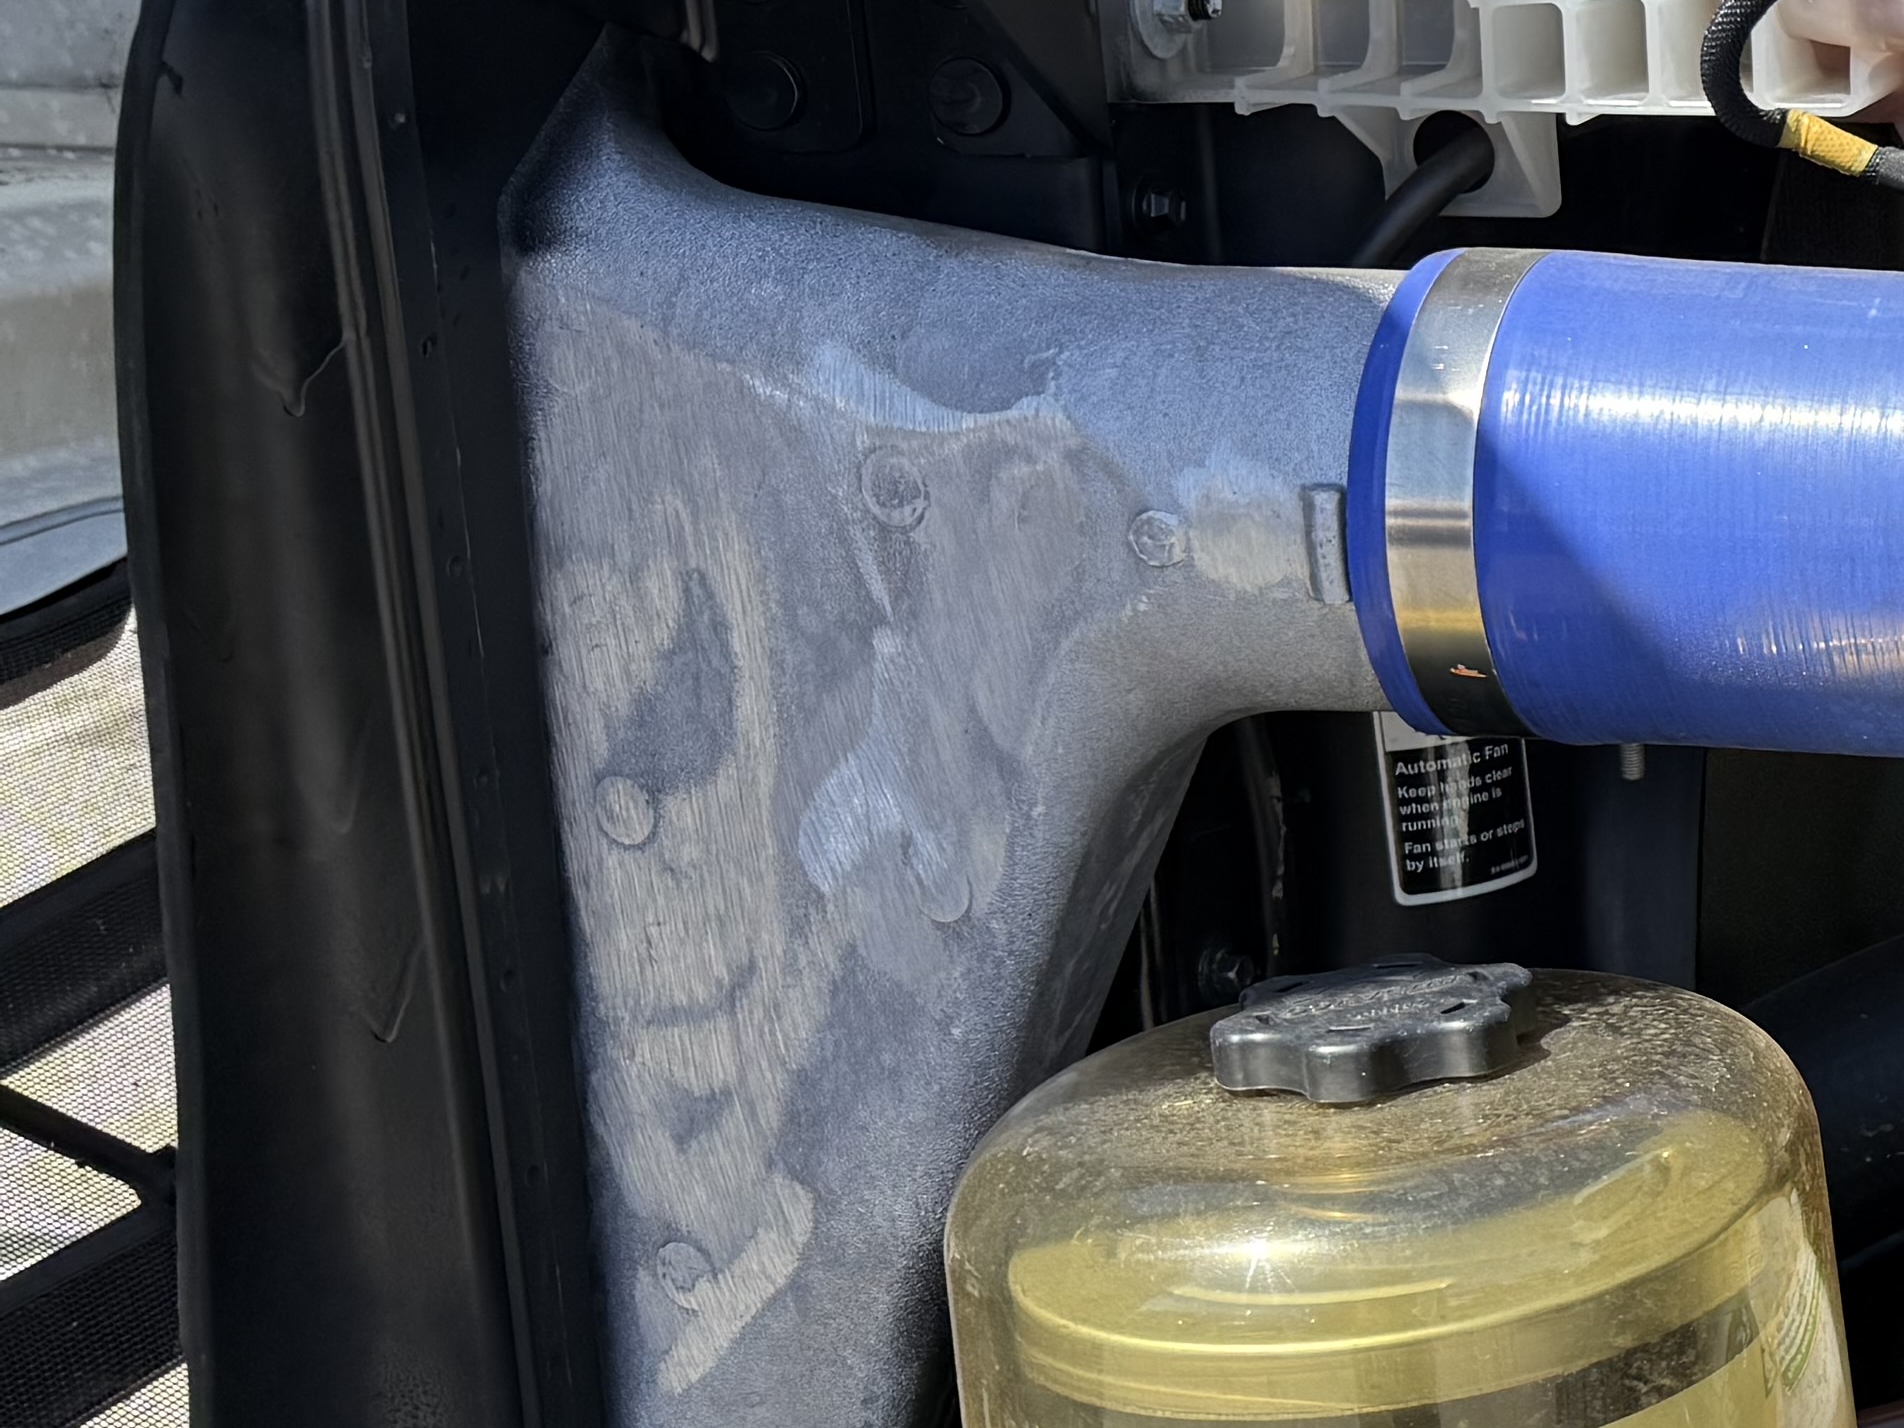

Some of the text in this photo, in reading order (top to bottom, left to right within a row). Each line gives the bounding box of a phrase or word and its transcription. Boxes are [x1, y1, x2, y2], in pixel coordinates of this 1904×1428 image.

[1395, 743, 1509, 776] Automatic Fan
[1398, 783, 1436, 799] Keep
[1400, 798, 1439, 815] when
[1404, 841, 1431, 855] Fan
[1480, 827, 1494, 842] or
[1406, 856, 1424, 873] by
